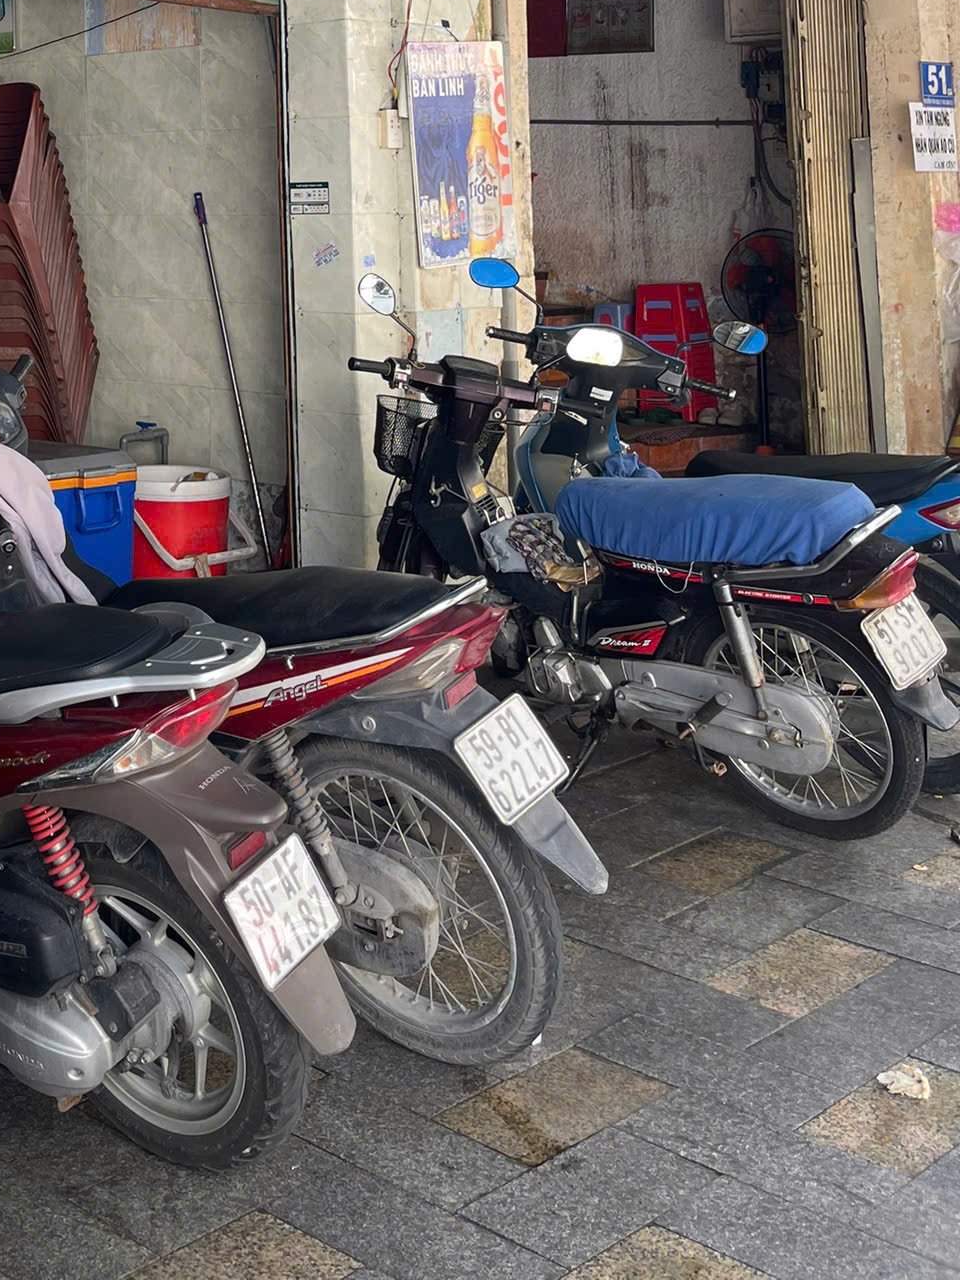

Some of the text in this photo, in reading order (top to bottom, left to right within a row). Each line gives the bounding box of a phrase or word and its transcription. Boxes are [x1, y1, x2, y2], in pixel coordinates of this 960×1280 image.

[928, 65, 947, 95] 51
[632, 561, 671, 575] HONDA
[598, 636, 640, 647] Dream
[893, 626, 936, 675] 9207
[468, 706, 529, 770] 59-B1
[197, 765, 232, 791] HONDA
[487, 737, 557, 813] 622.47
[239, 846, 303, 928] 50-AF
